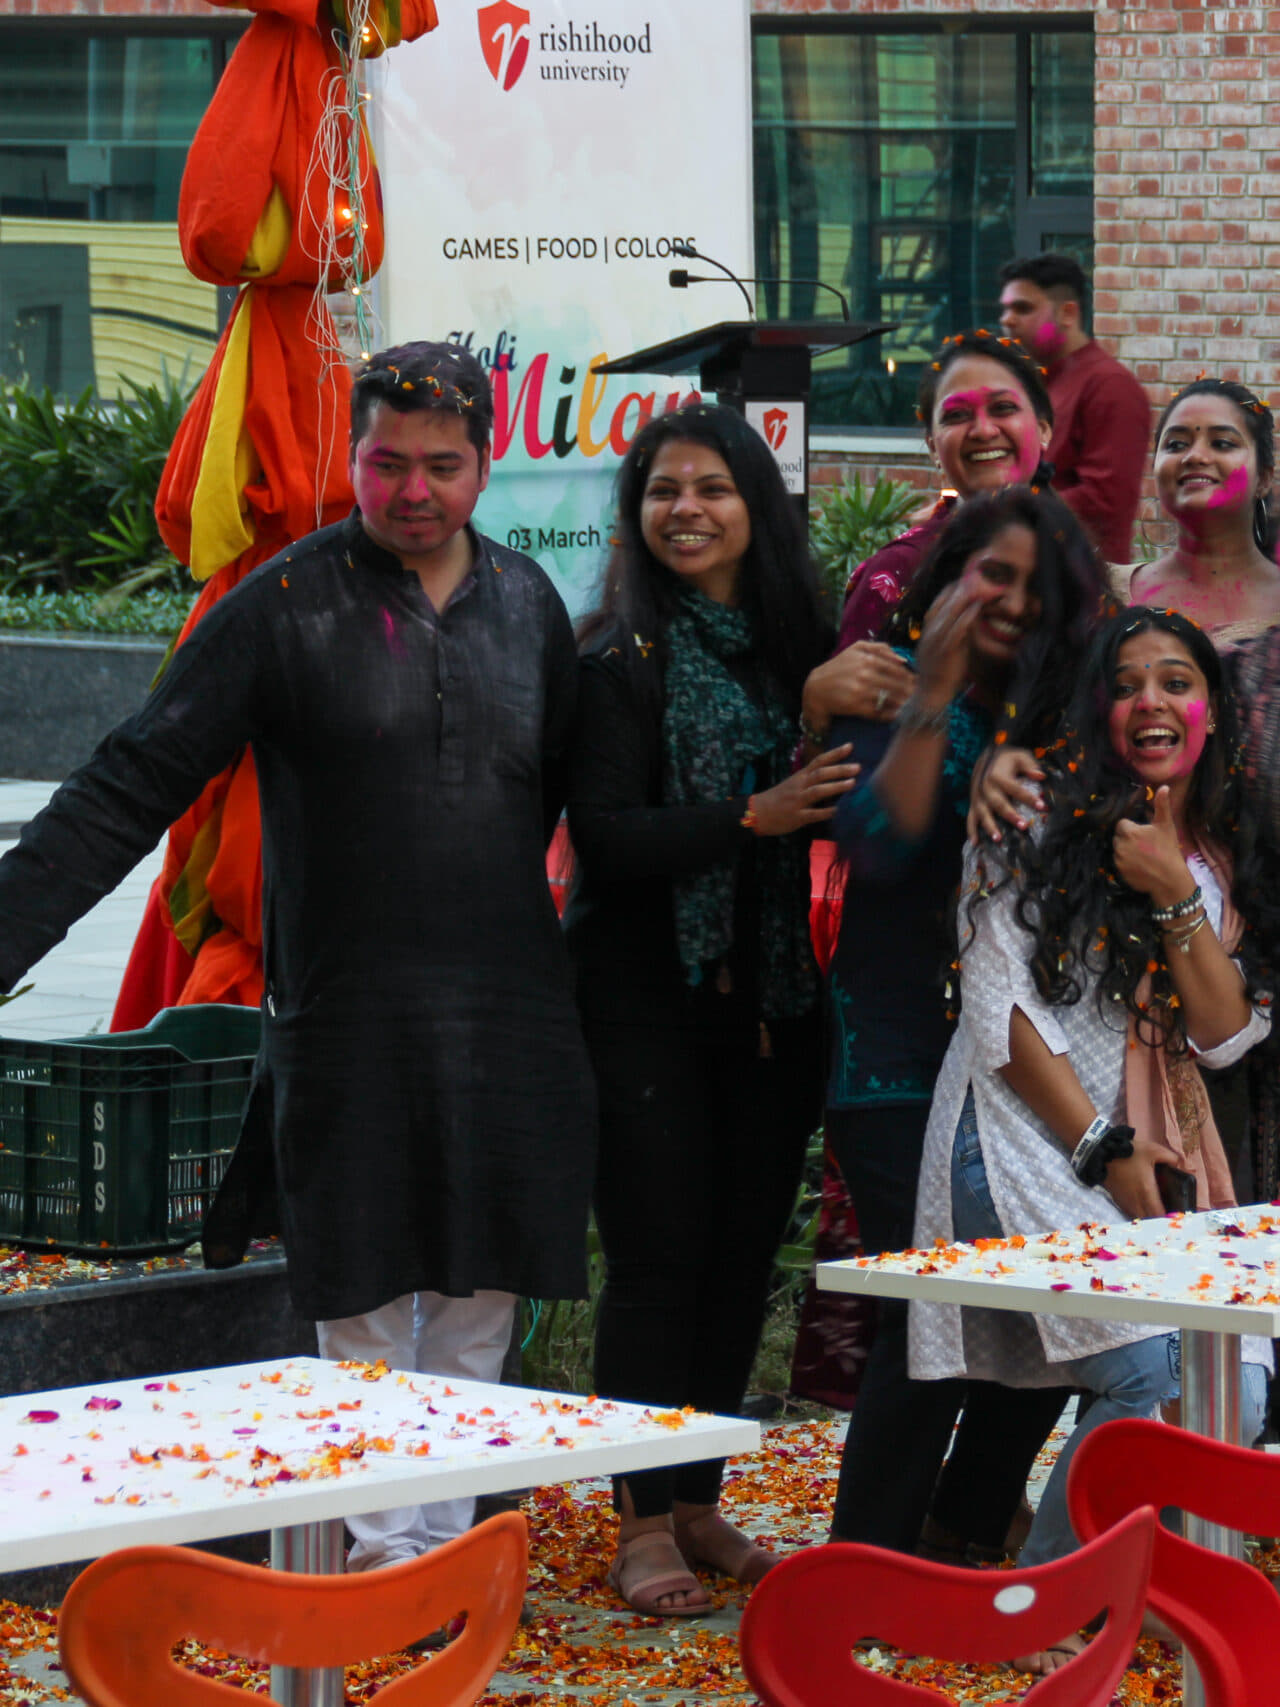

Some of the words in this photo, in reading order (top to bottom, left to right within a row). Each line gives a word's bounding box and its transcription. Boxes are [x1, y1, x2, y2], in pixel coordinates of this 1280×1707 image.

[539, 20, 652, 54] rishihood
[540, 59, 630, 89] university
[443, 238, 519, 260] GAMES
[537, 237, 598, 259] FOOD
[489, 352, 702, 460] Mila
[507, 528, 532, 550] 03
[538, 525, 600, 549] March
